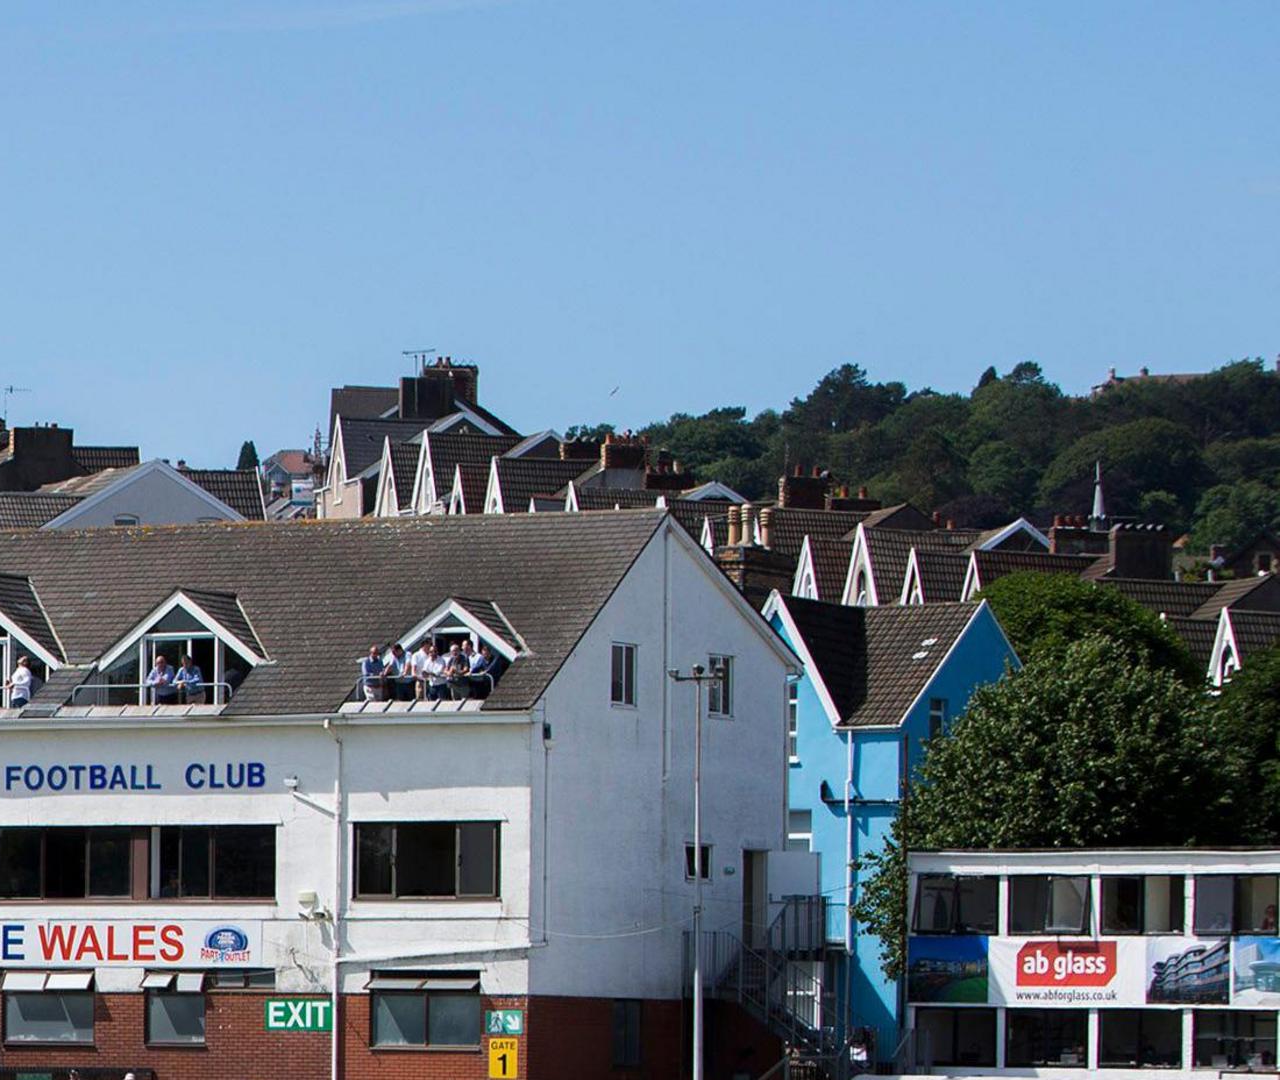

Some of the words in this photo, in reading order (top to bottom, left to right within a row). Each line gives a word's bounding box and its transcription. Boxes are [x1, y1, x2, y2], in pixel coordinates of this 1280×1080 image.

[5, 763, 161, 792] FOOTBALL
[184, 762, 266, 789] CLUB
[38, 924, 184, 962] WALES
[1023, 950, 1049, 974] ab
[1053, 950, 1107, 979] glass
[1016, 989, 1118, 1003] www.abforglass.co.uk
[268, 1001, 330, 1028] EXIT
[491, 1041, 517, 1050] GATE
[497, 1053, 507, 1076] 1
